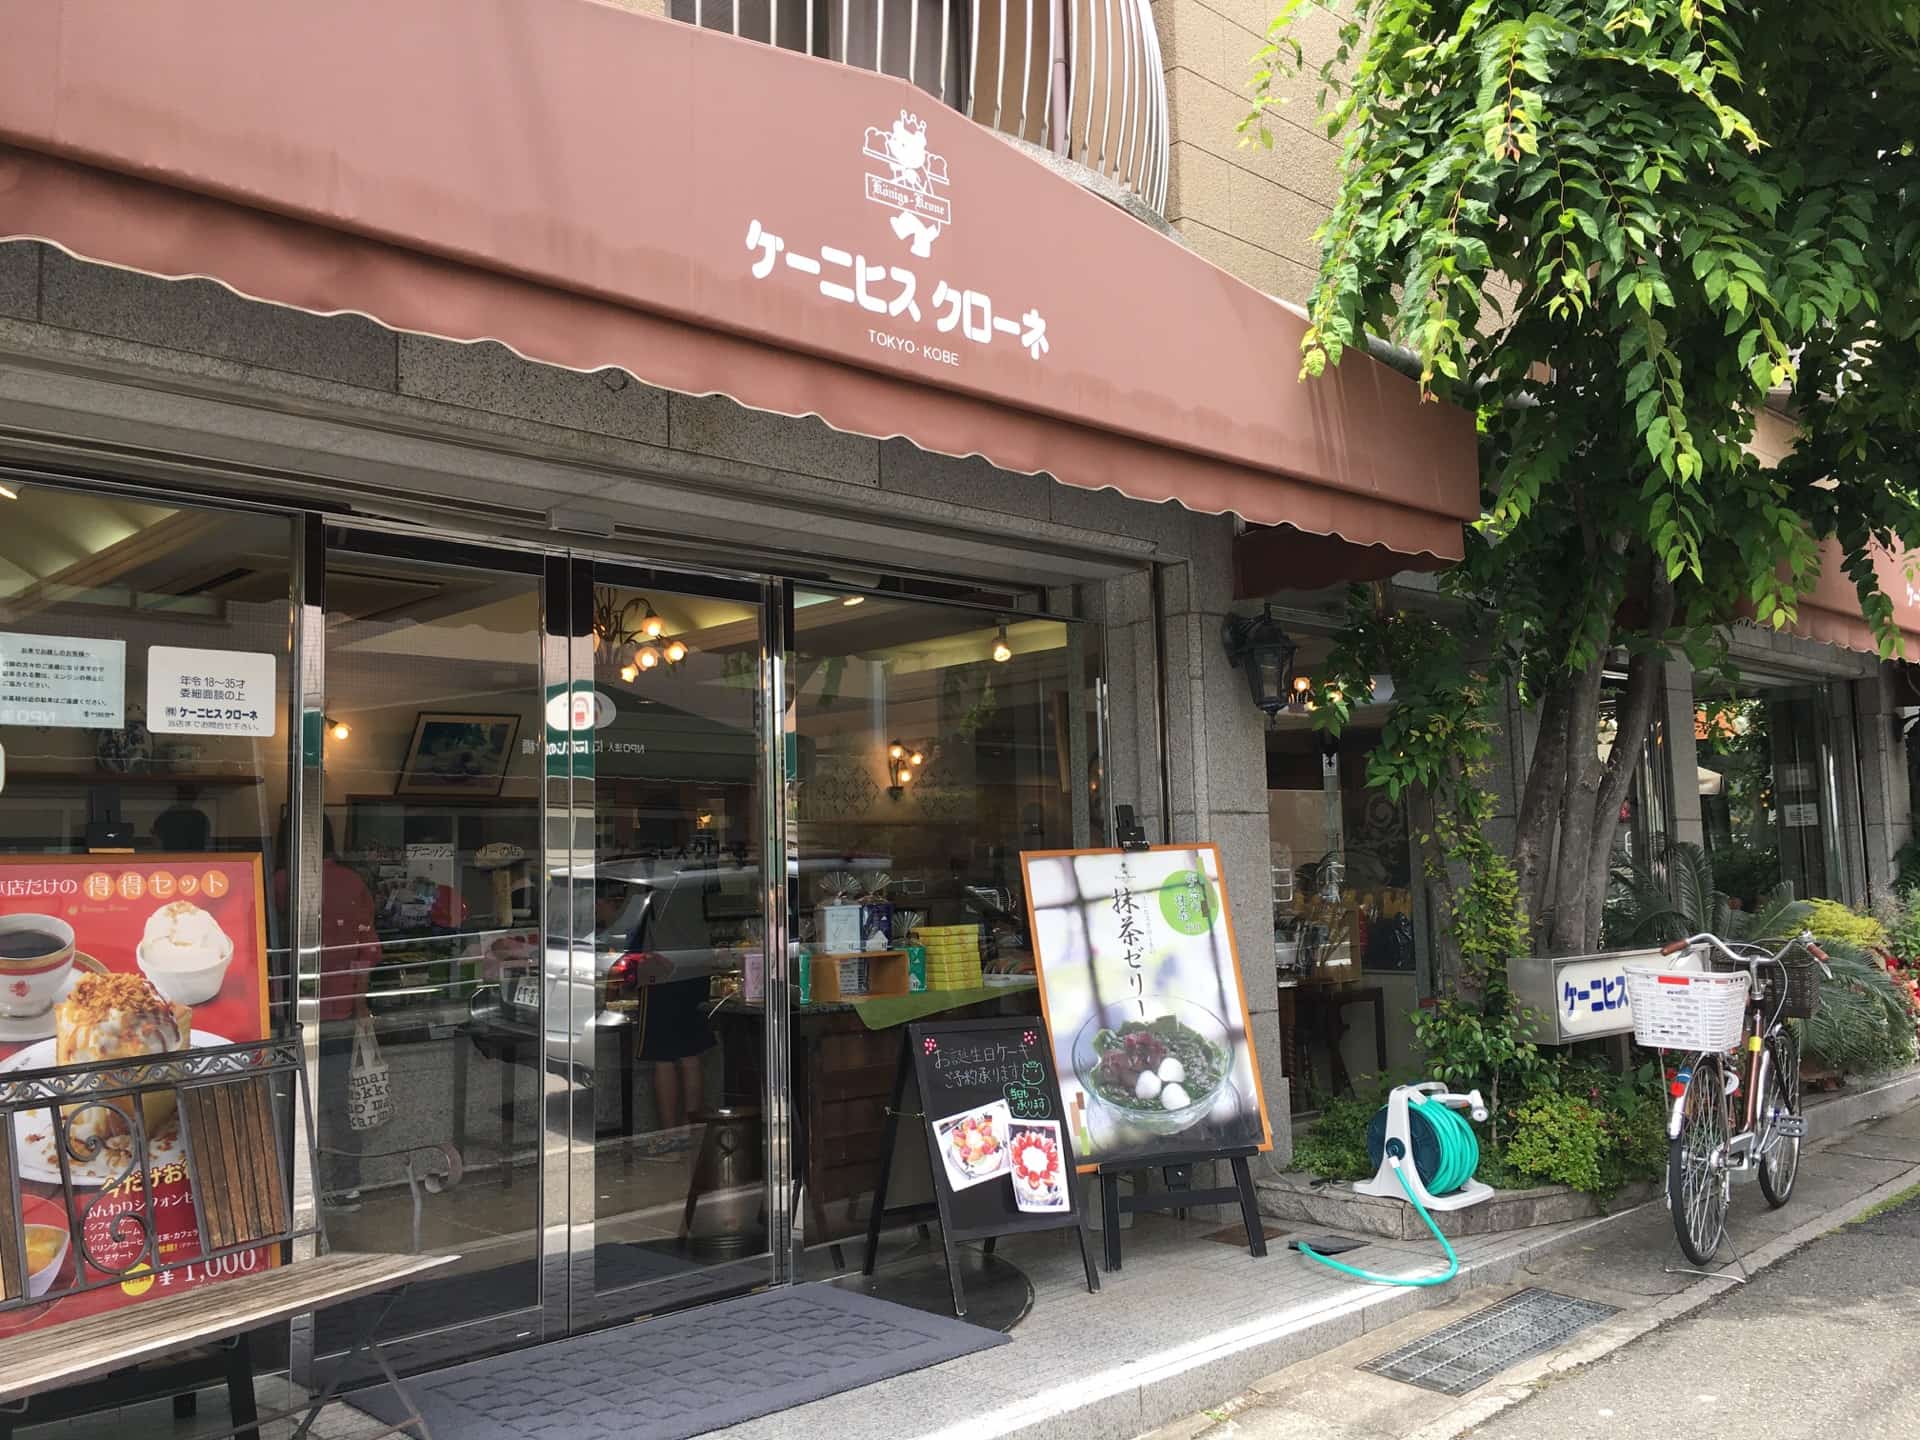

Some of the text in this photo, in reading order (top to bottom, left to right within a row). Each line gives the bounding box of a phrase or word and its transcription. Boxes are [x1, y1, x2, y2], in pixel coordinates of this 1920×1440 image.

[746, 219, 1049, 360] ケーニヒス クローネ
[179, 707, 222, 719] ケーニヒス
[225, 709, 258, 721] クローネ
[0, 872, 225, 898] 店だけの 得得セット
[1111, 886, 1146, 1017] 抹茶ゼリー
